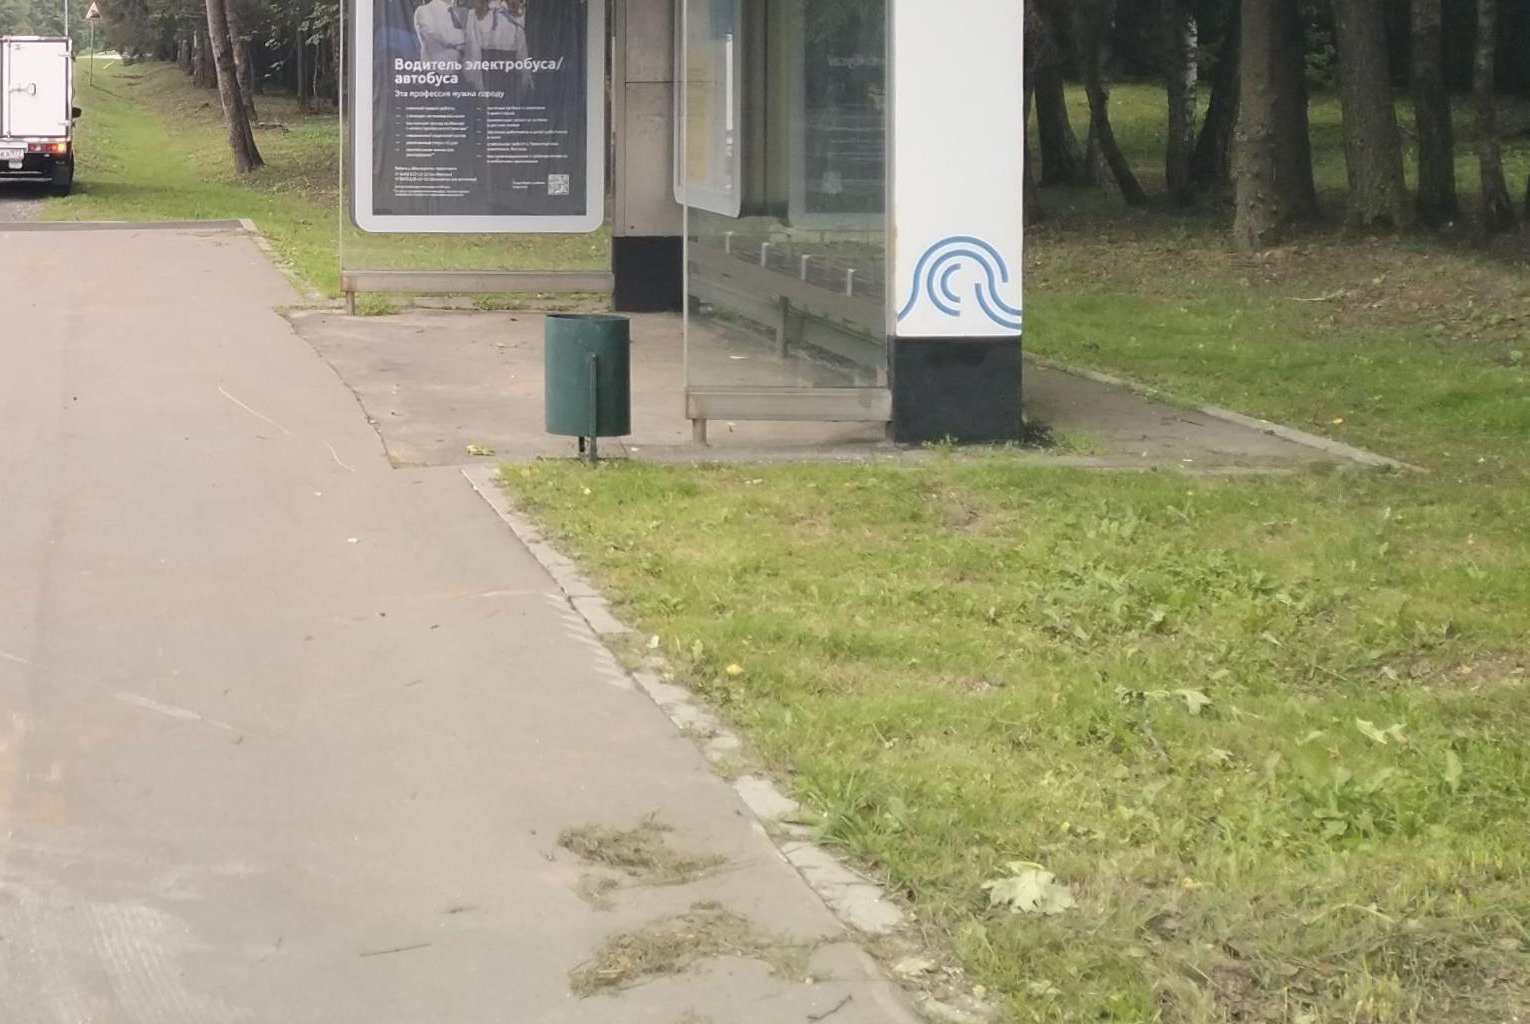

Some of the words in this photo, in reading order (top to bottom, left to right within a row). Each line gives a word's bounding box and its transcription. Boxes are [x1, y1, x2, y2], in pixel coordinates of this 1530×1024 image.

[394, 58, 463, 71] Водитель
[465, 56, 563, 73] электробуса/
[394, 71, 459, 86] автобуса
[477, 90, 504, 99] городу
